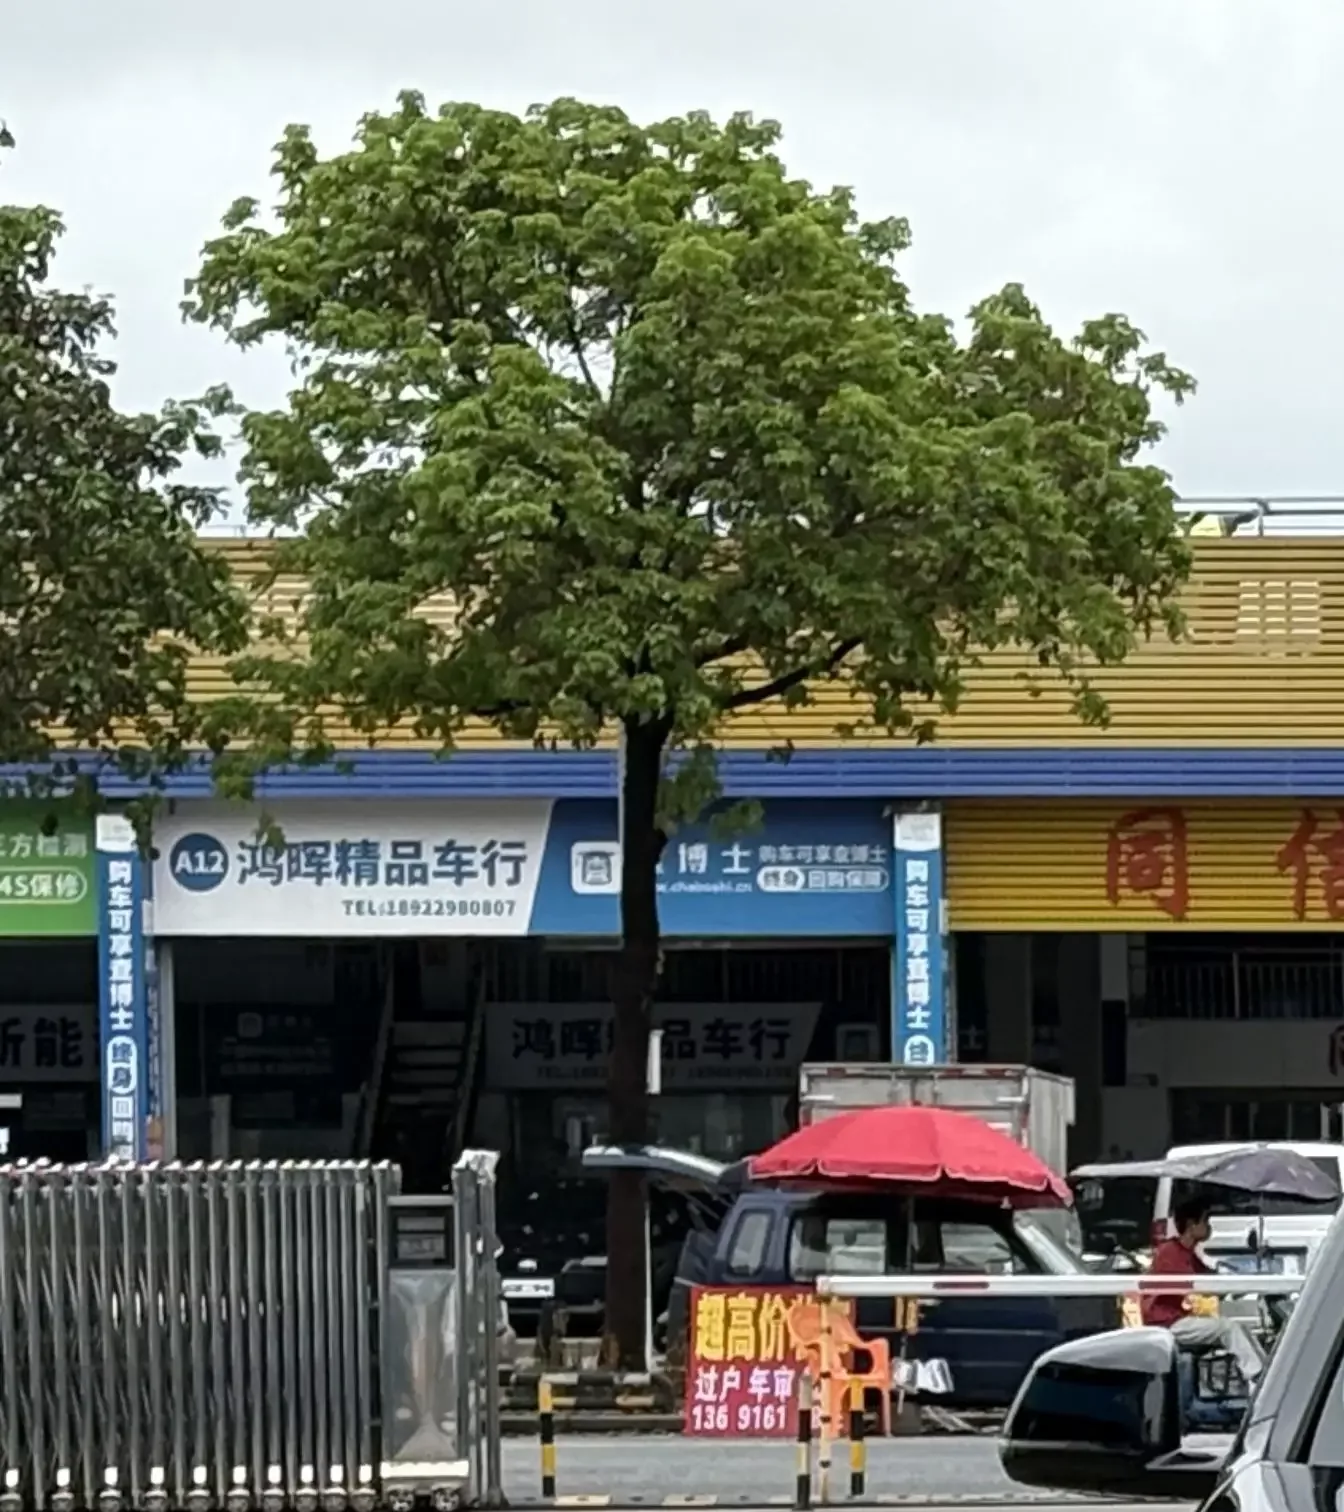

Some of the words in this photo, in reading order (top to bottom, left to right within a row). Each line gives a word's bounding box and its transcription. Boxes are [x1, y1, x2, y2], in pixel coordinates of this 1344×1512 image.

[0, 833, 88, 859] 方检测
[174, 849, 225, 875] A12
[656, 842, 752, 875] 博士
[237, 838, 528, 888] 鸿晖精品车行
[512, 1017, 791, 1061] 鸿晖品车行
